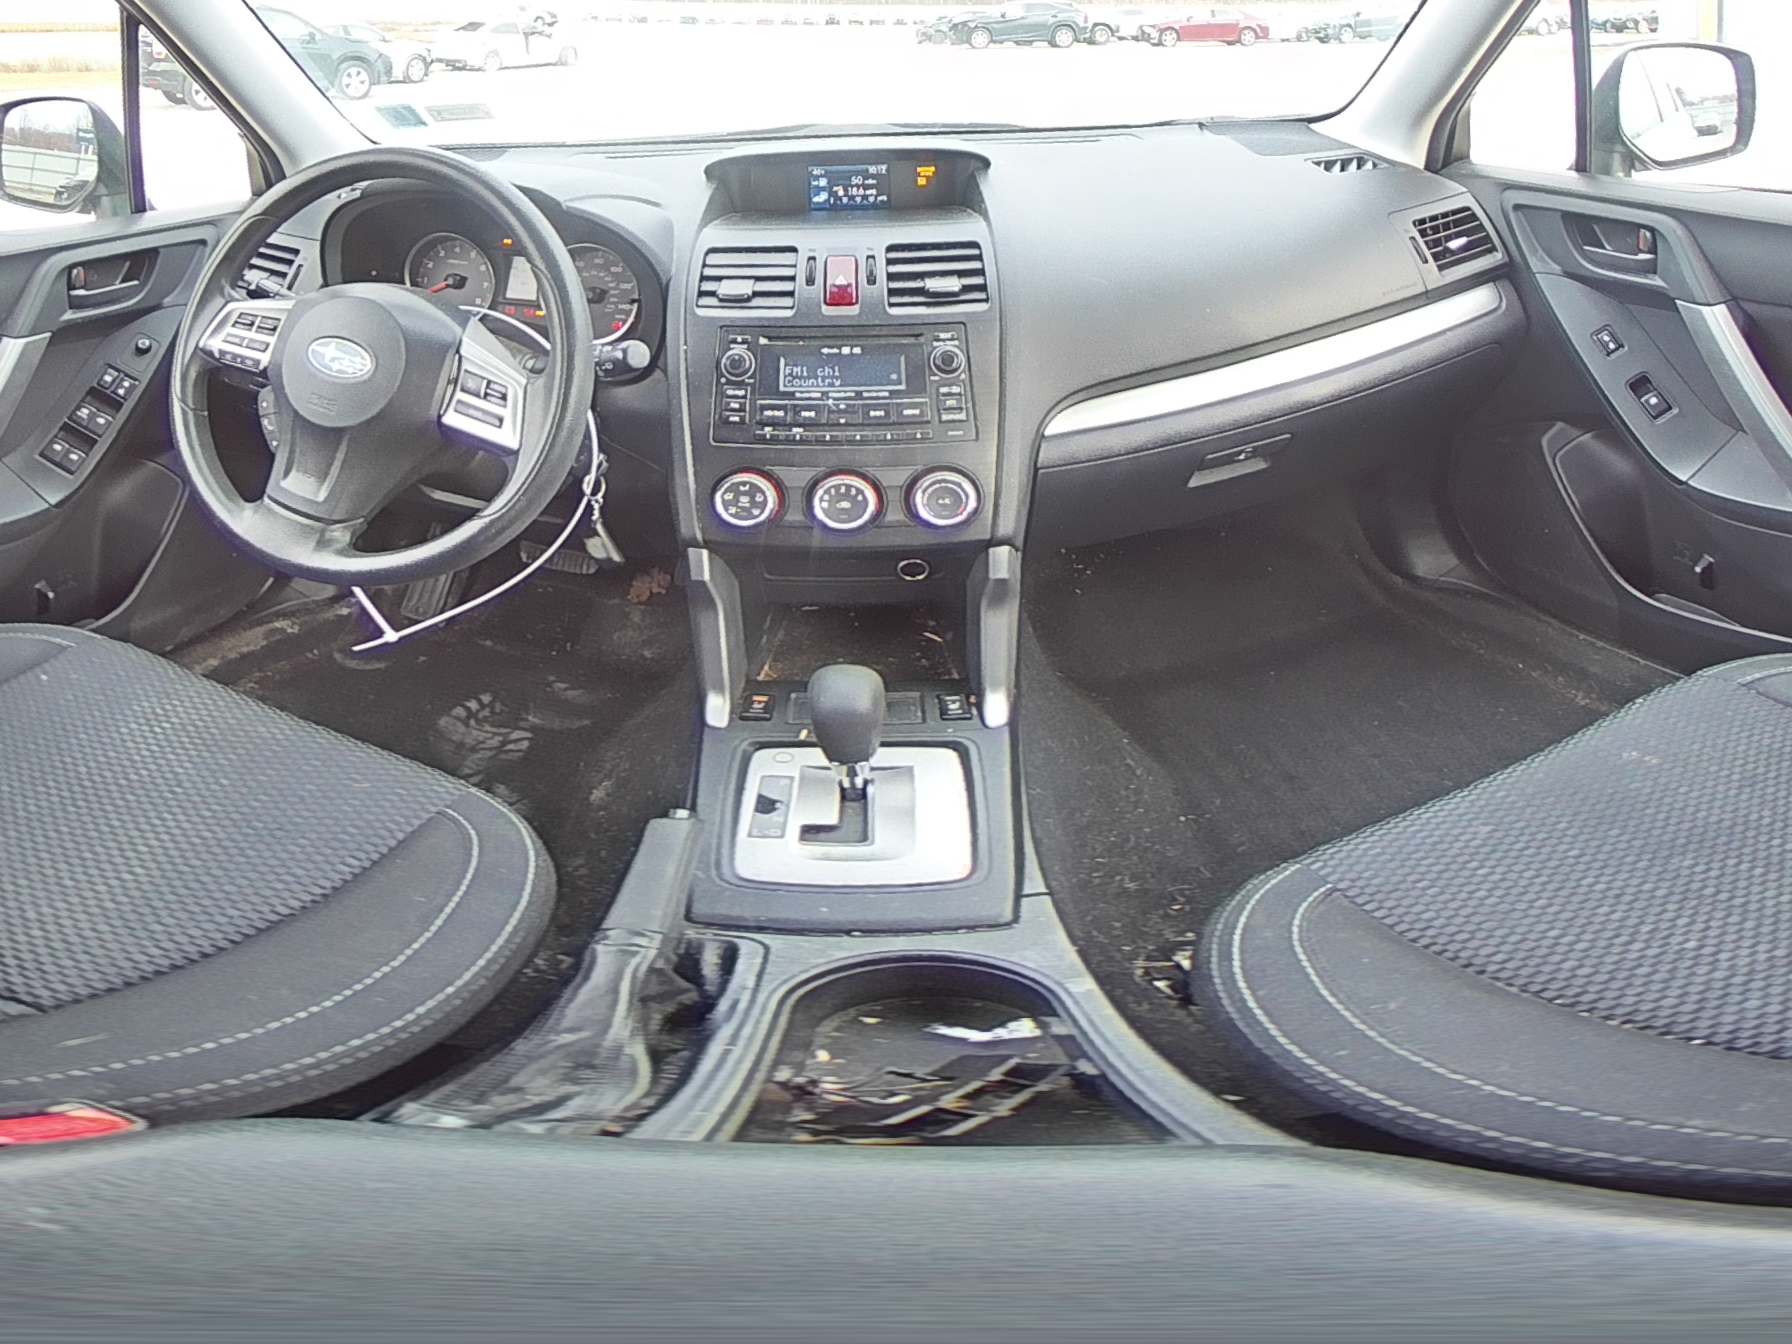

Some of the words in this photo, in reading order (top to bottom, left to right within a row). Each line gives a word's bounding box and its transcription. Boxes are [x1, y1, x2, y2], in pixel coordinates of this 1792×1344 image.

[851, 176, 863, 185] 50
[785, 366, 808, 376] FM1
[817, 366, 840, 376] ch1
[785, 377, 841, 387] Country
